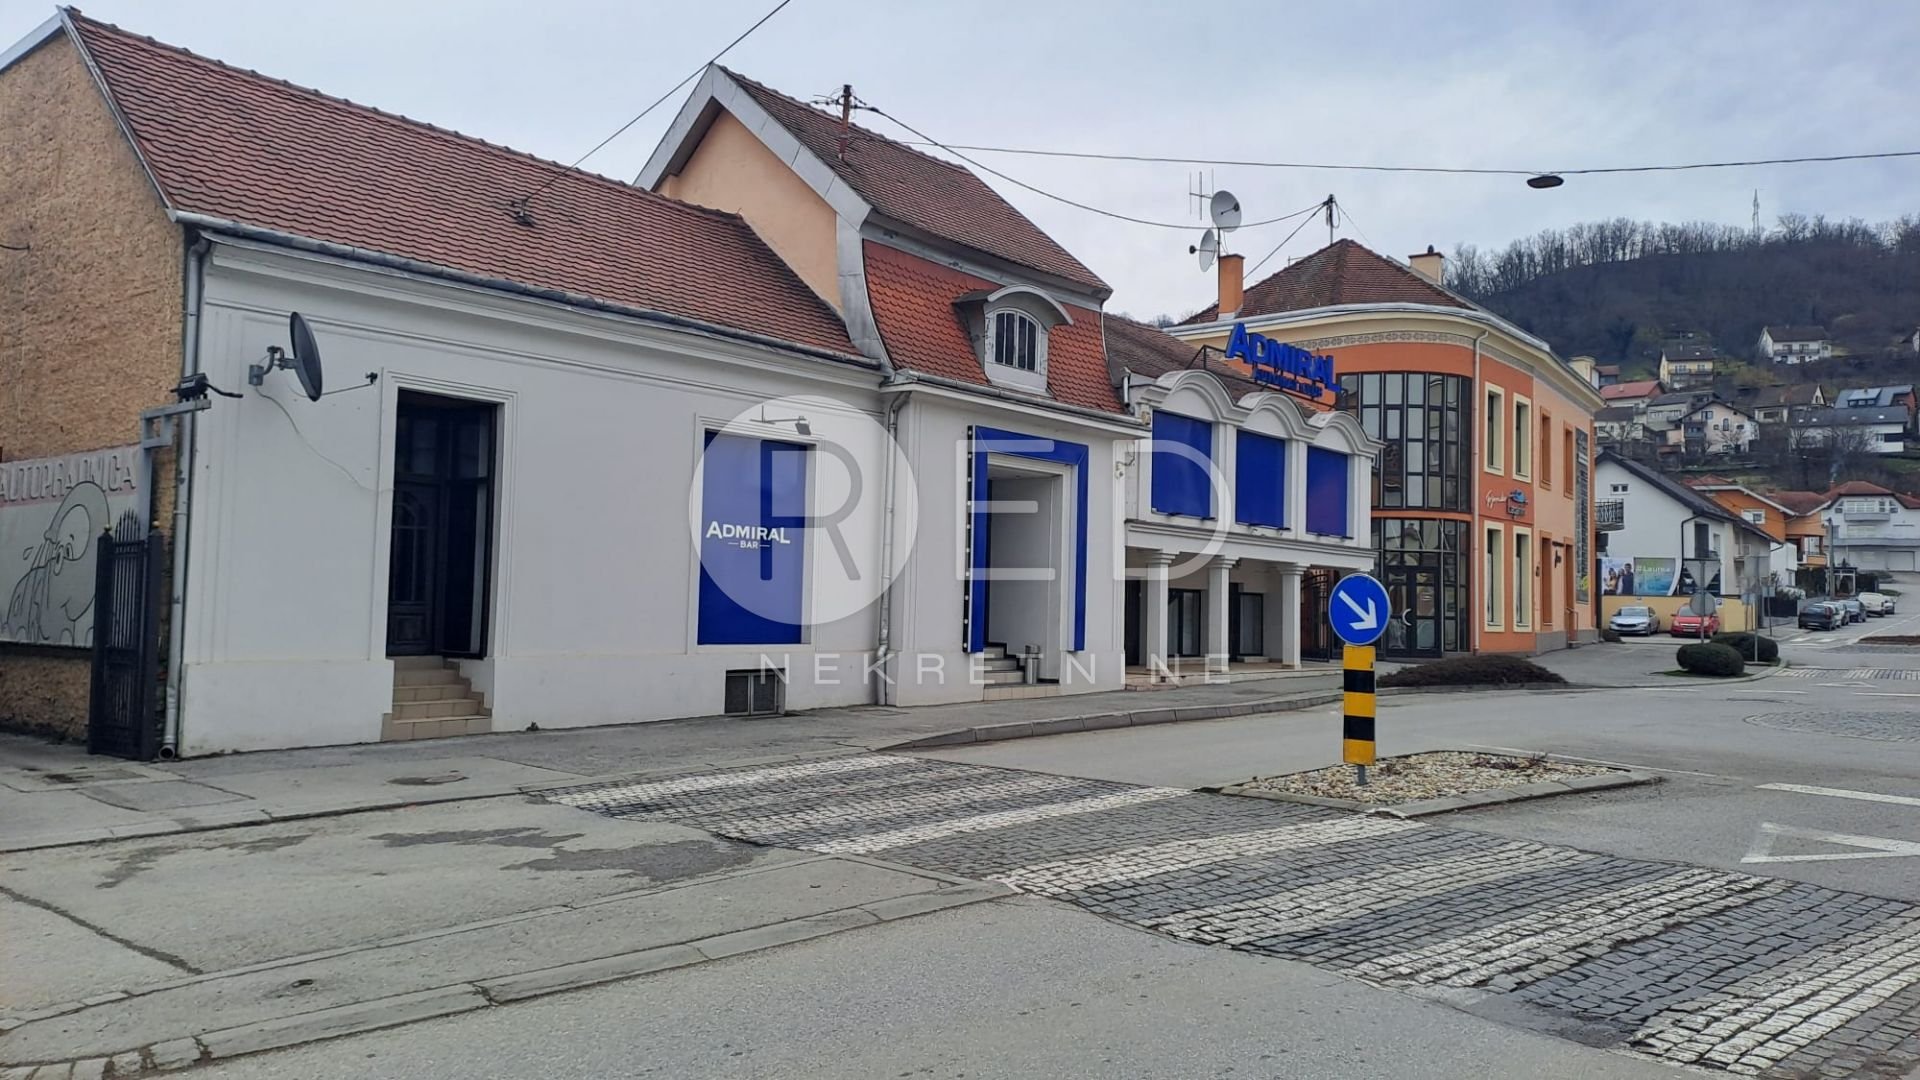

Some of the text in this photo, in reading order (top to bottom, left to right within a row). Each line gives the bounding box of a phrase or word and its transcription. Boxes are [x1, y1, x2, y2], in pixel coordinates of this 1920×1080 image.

[1225, 322, 1341, 392] ADMIRAL
[707, 521, 790, 543] ADMIRAL
[740, 540, 758, 549] BAR
